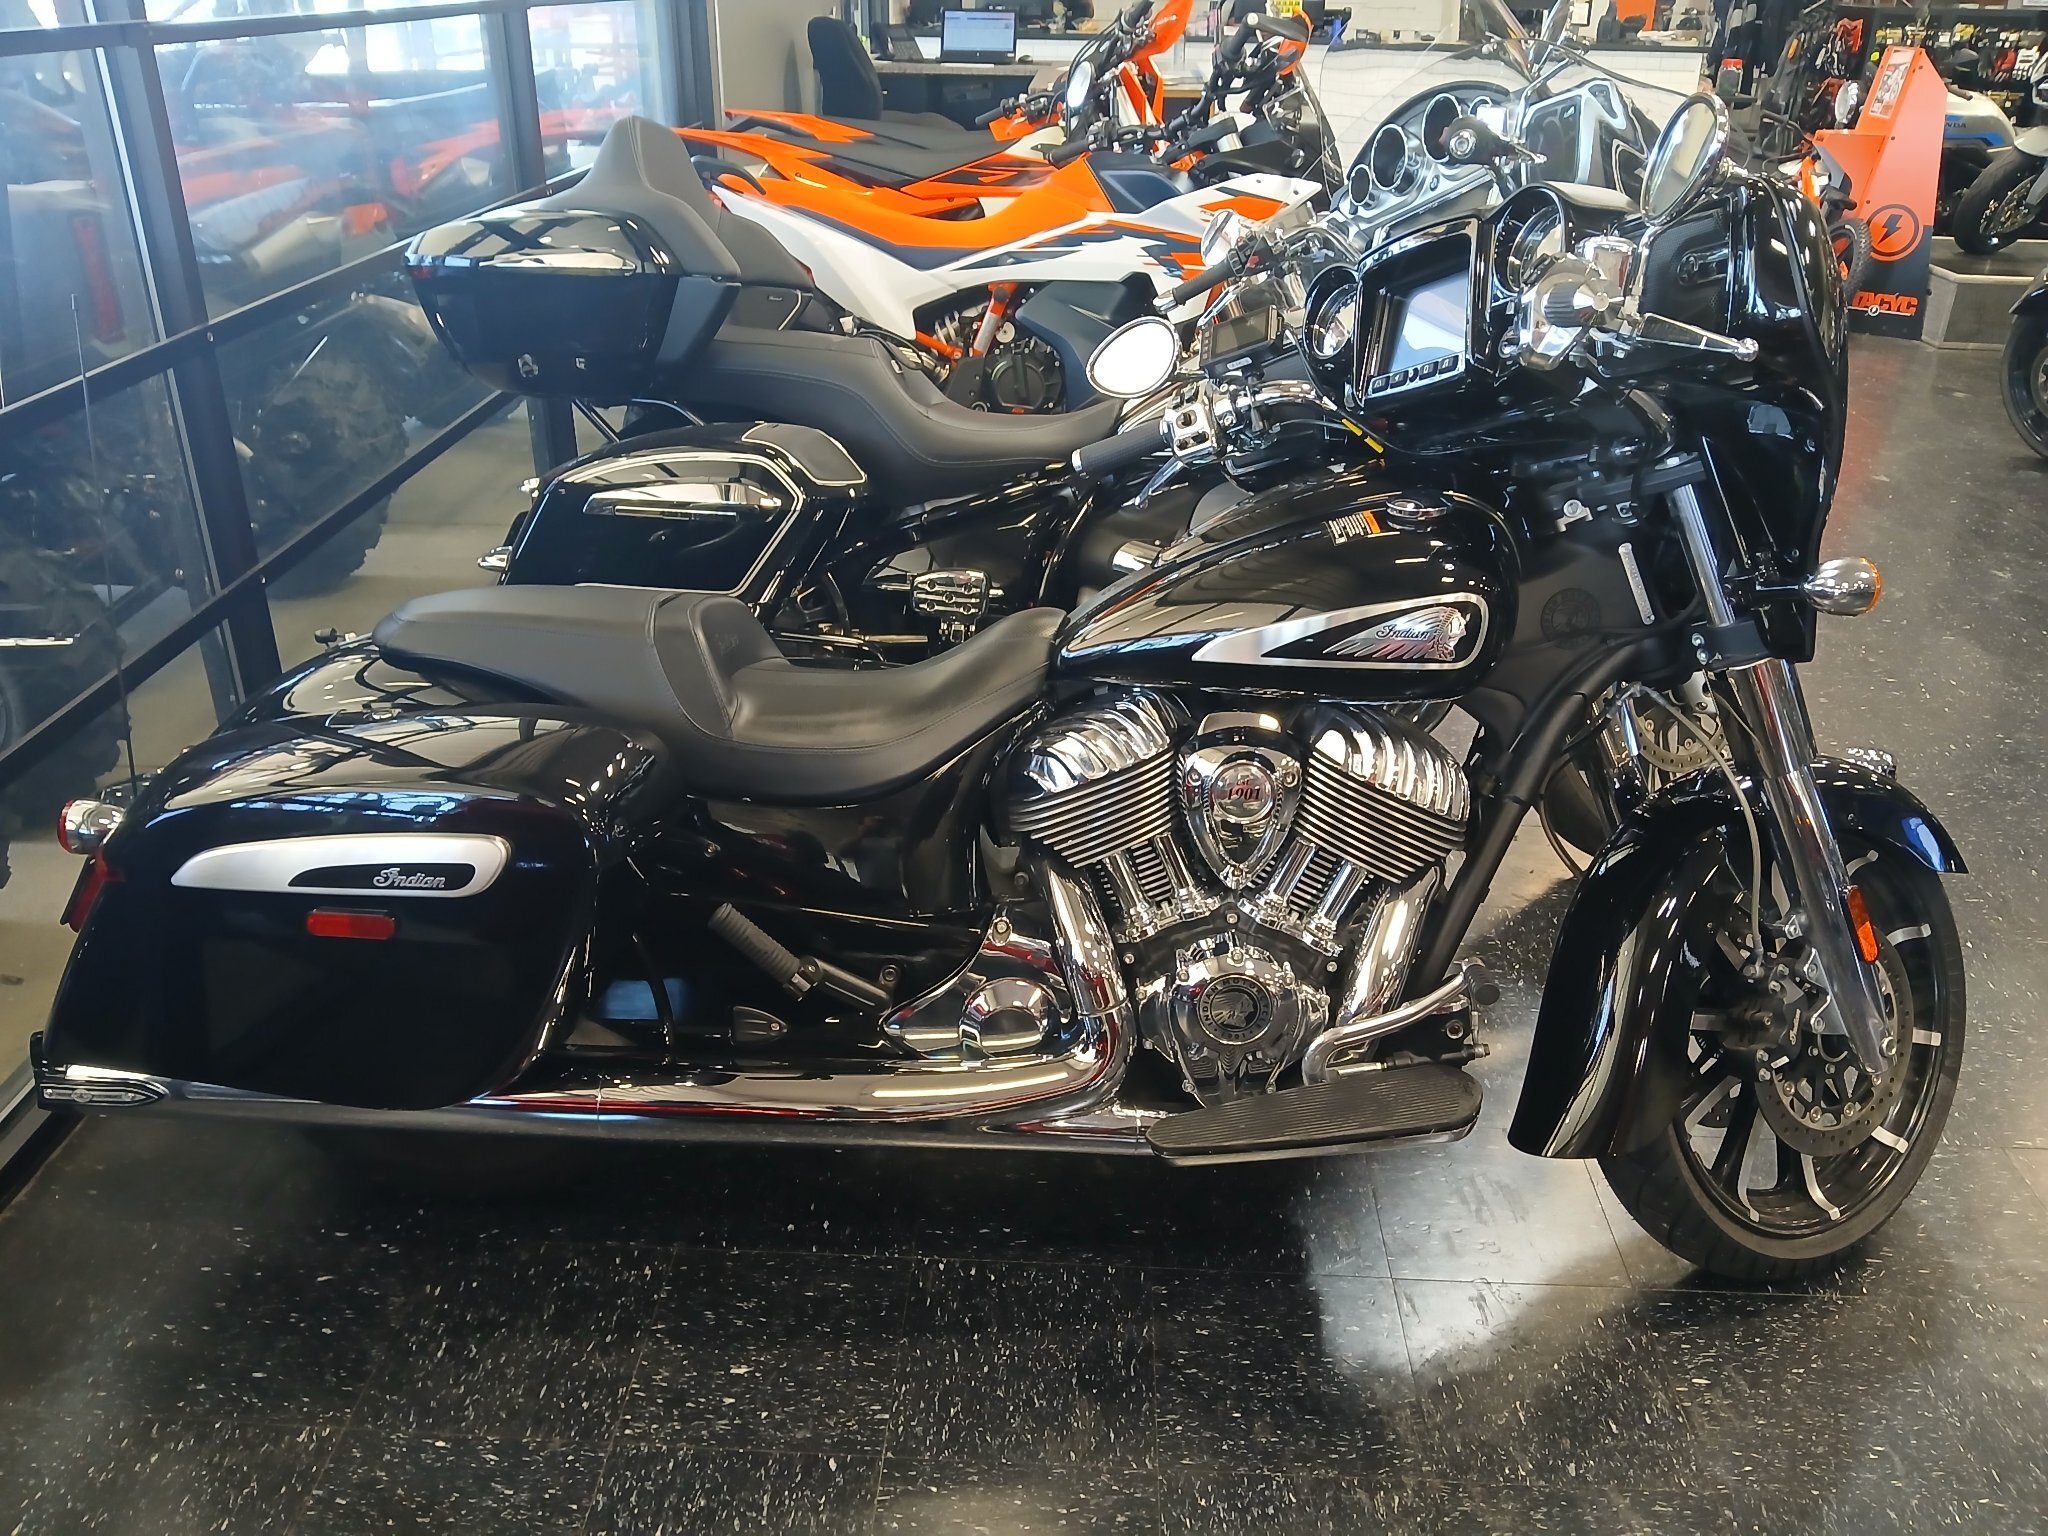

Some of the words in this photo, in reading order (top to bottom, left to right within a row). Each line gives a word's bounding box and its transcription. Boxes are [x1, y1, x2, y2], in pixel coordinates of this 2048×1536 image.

[1851, 290, 1918, 315] TACYC
[1375, 623, 1430, 640] Indian
[1228, 787, 1261, 801] 1901
[373, 867, 446, 888] Indian
[1202, 984, 1219, 1027] INDIAN
